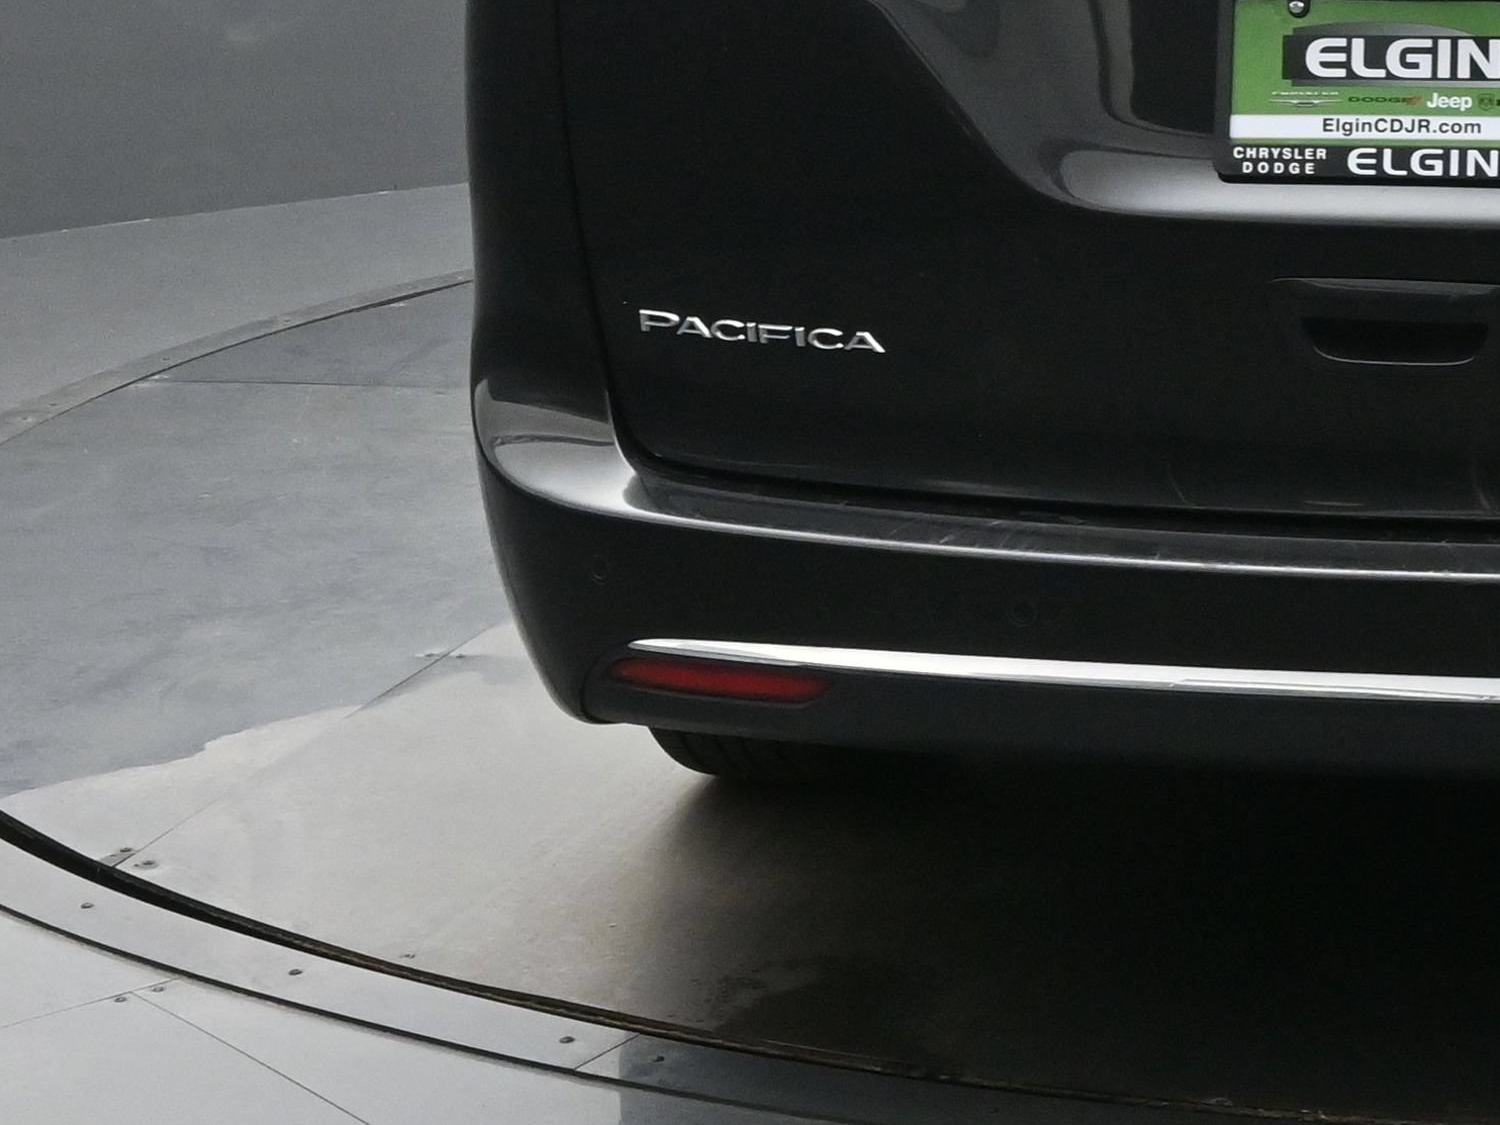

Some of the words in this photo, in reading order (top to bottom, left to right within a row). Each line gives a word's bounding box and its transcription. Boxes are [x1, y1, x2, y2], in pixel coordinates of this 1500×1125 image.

[1426, 92, 1473, 111] Jeep
[1323, 118, 1482, 137] ElginCDJR.com
[1233, 147, 1327, 160] CHRYSLER
[1346, 148, 1500, 178] ELGIN
[1242, 161, 1316, 175] DODGE
[638, 308, 886, 353] PACIFICA
